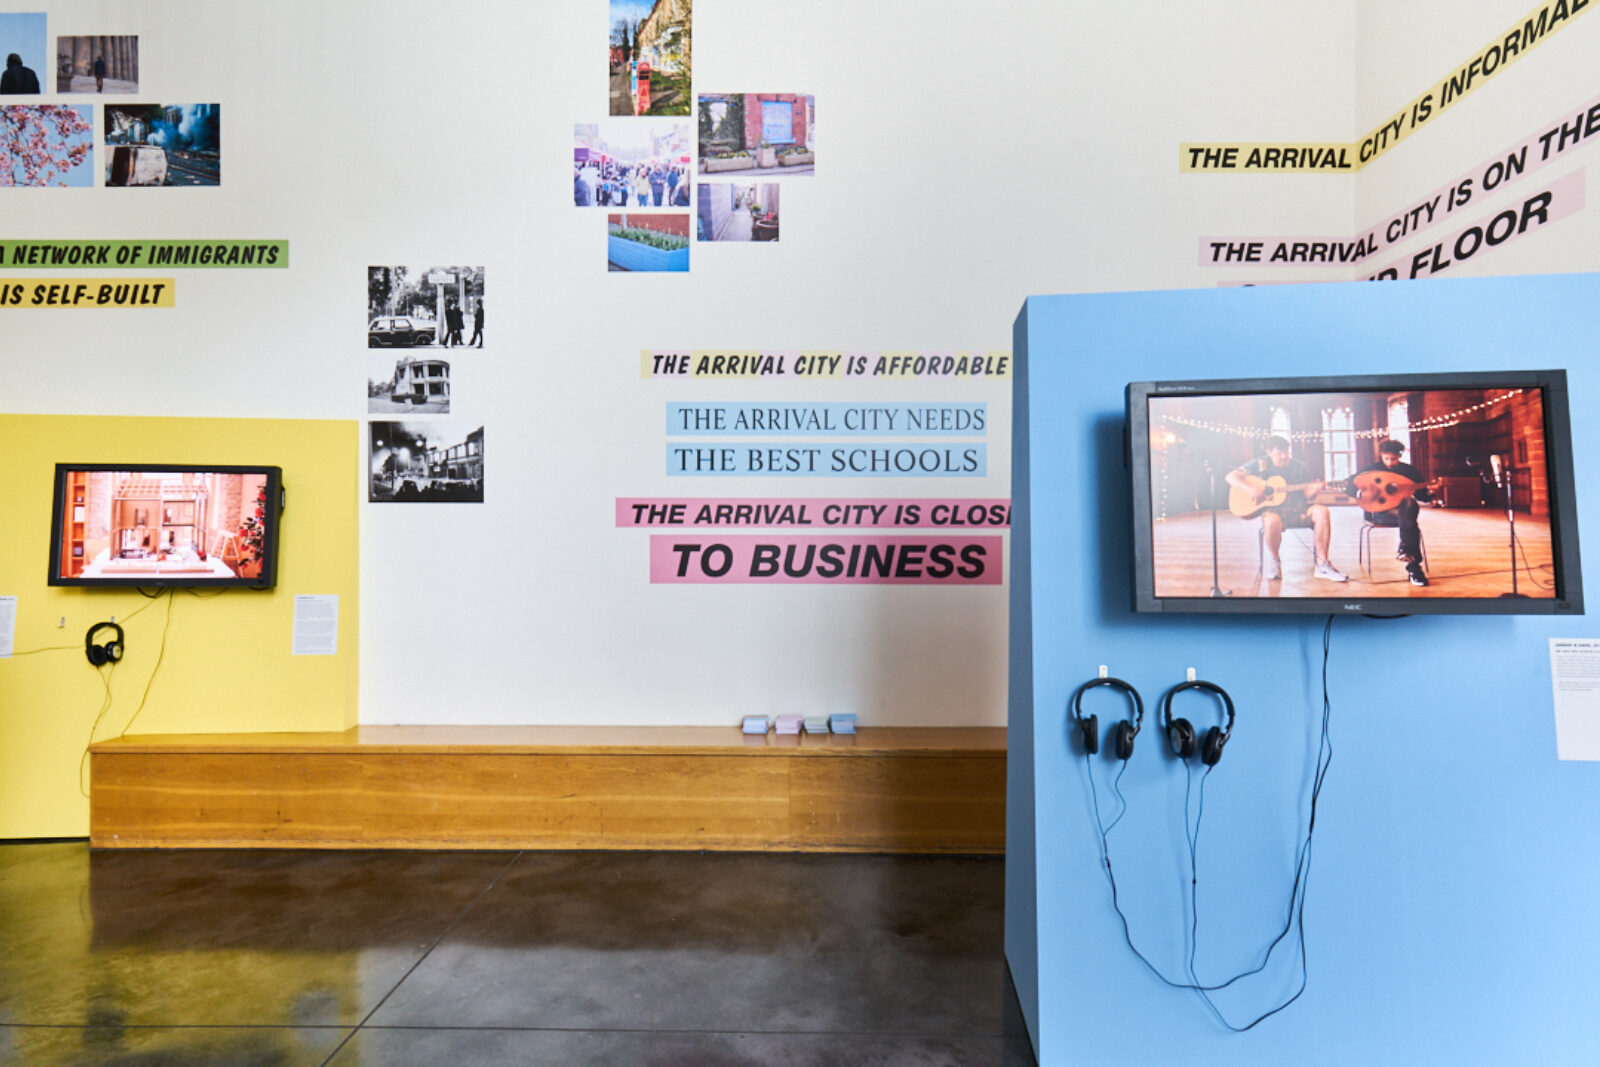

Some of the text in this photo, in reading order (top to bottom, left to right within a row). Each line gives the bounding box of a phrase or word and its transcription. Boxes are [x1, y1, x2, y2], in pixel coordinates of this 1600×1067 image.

[1189, 148, 1238, 168] THE
[1245, 148, 1351, 168] ARRIVAL
[1360, 114, 1405, 162] CITY
[1411, 95, 1432, 128] IS
[1211, 104, 1600, 262] THE ARRIVAL CITY IS ON THE
[1409, 191, 1552, 280] FLOOR
[13, 245, 110, 264] NETWORK
[116, 246, 142, 264] OF
[148, 245, 279, 264] IMMIGRANTS
[1, 285, 165, 304] IS SELF-BUILT
[654, 355, 1008, 375] THE ARRIVAL CITY IS AFFORDABLE
[678, 408, 985, 431] THE ARRIVAL CITY NEEDS
[675, 449, 978, 472] THE BEST SCHOOLS
[632, 505, 686, 523] THE
[694, 505, 811, 524] ARRIVAL
[823, 505, 887, 525] CITY
[895, 505, 920, 525] IS
[673, 544, 986, 579] TO BUSINESS
